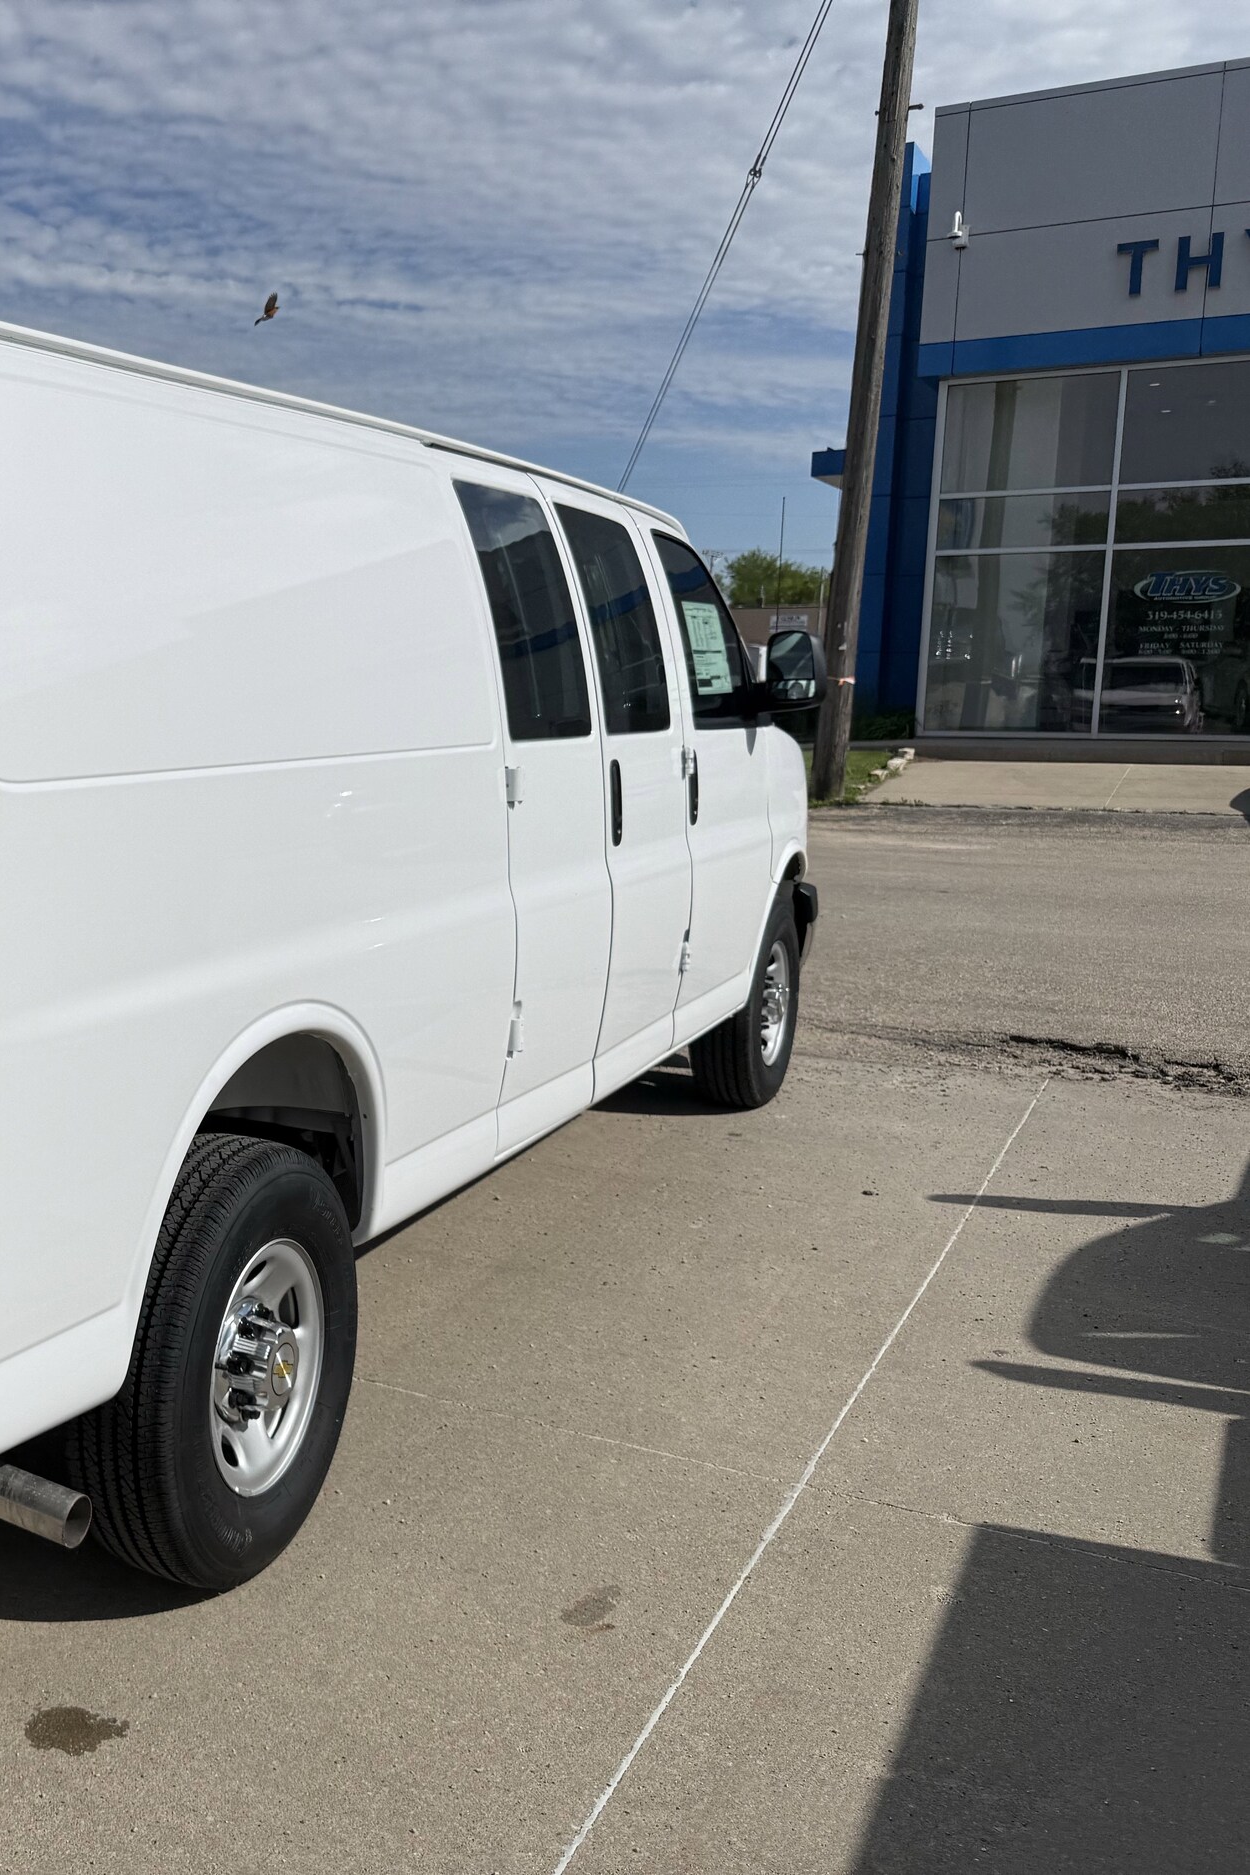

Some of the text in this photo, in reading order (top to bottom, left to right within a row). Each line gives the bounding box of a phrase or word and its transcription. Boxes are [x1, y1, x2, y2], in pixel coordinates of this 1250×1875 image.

[1116, 227, 1250, 297] TH
[1147, 570, 1229, 597] THYS
[1182, 624, 1225, 632] THURSDAY
[1139, 641, 1170, 649] FRIDAY
[1179, 640, 1224, 648] SATURDAY
